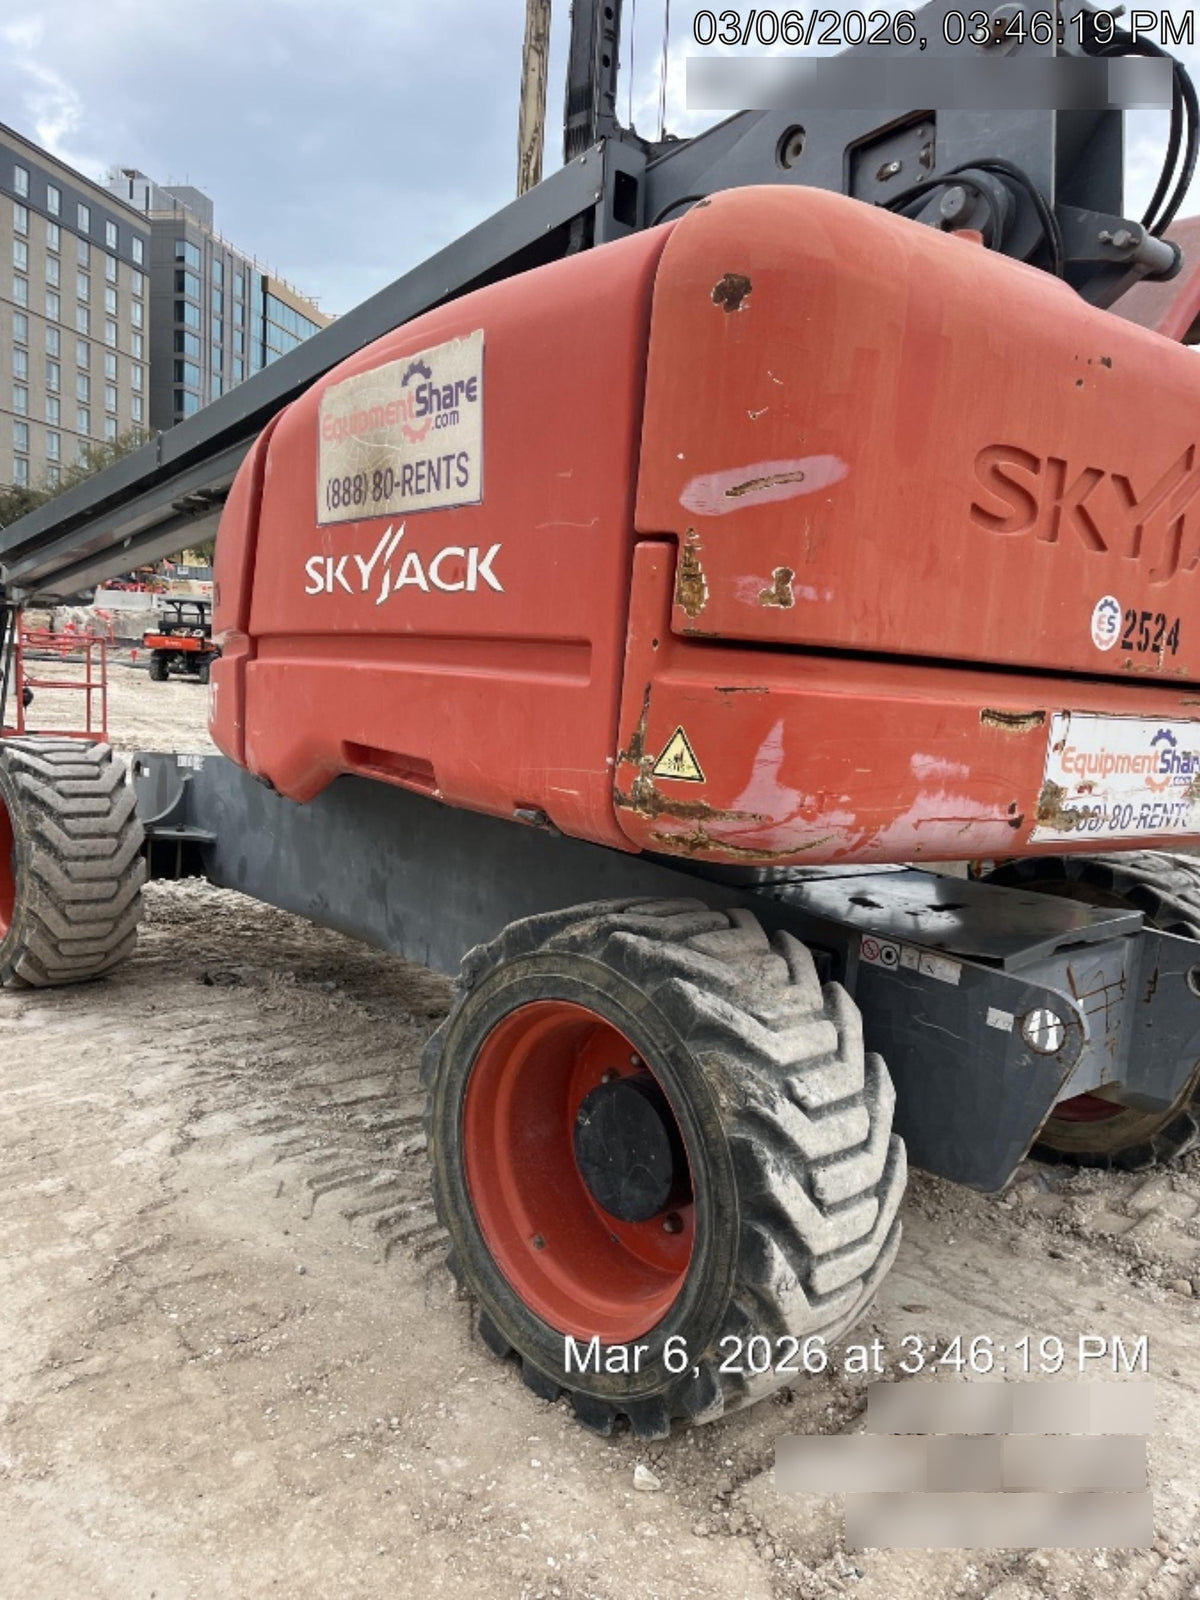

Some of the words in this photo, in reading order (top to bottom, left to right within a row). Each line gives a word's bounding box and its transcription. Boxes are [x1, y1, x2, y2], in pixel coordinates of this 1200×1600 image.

[322, 376, 478, 443] EquipmentShare
[326, 472, 367, 511] (888)
[372, 451, 470, 501] 80-RENTS
[305, 521, 506, 605] SKYJACK
[1121, 609, 1180, 656] 2524
[1061, 746, 1200, 779] EquipmentShar
